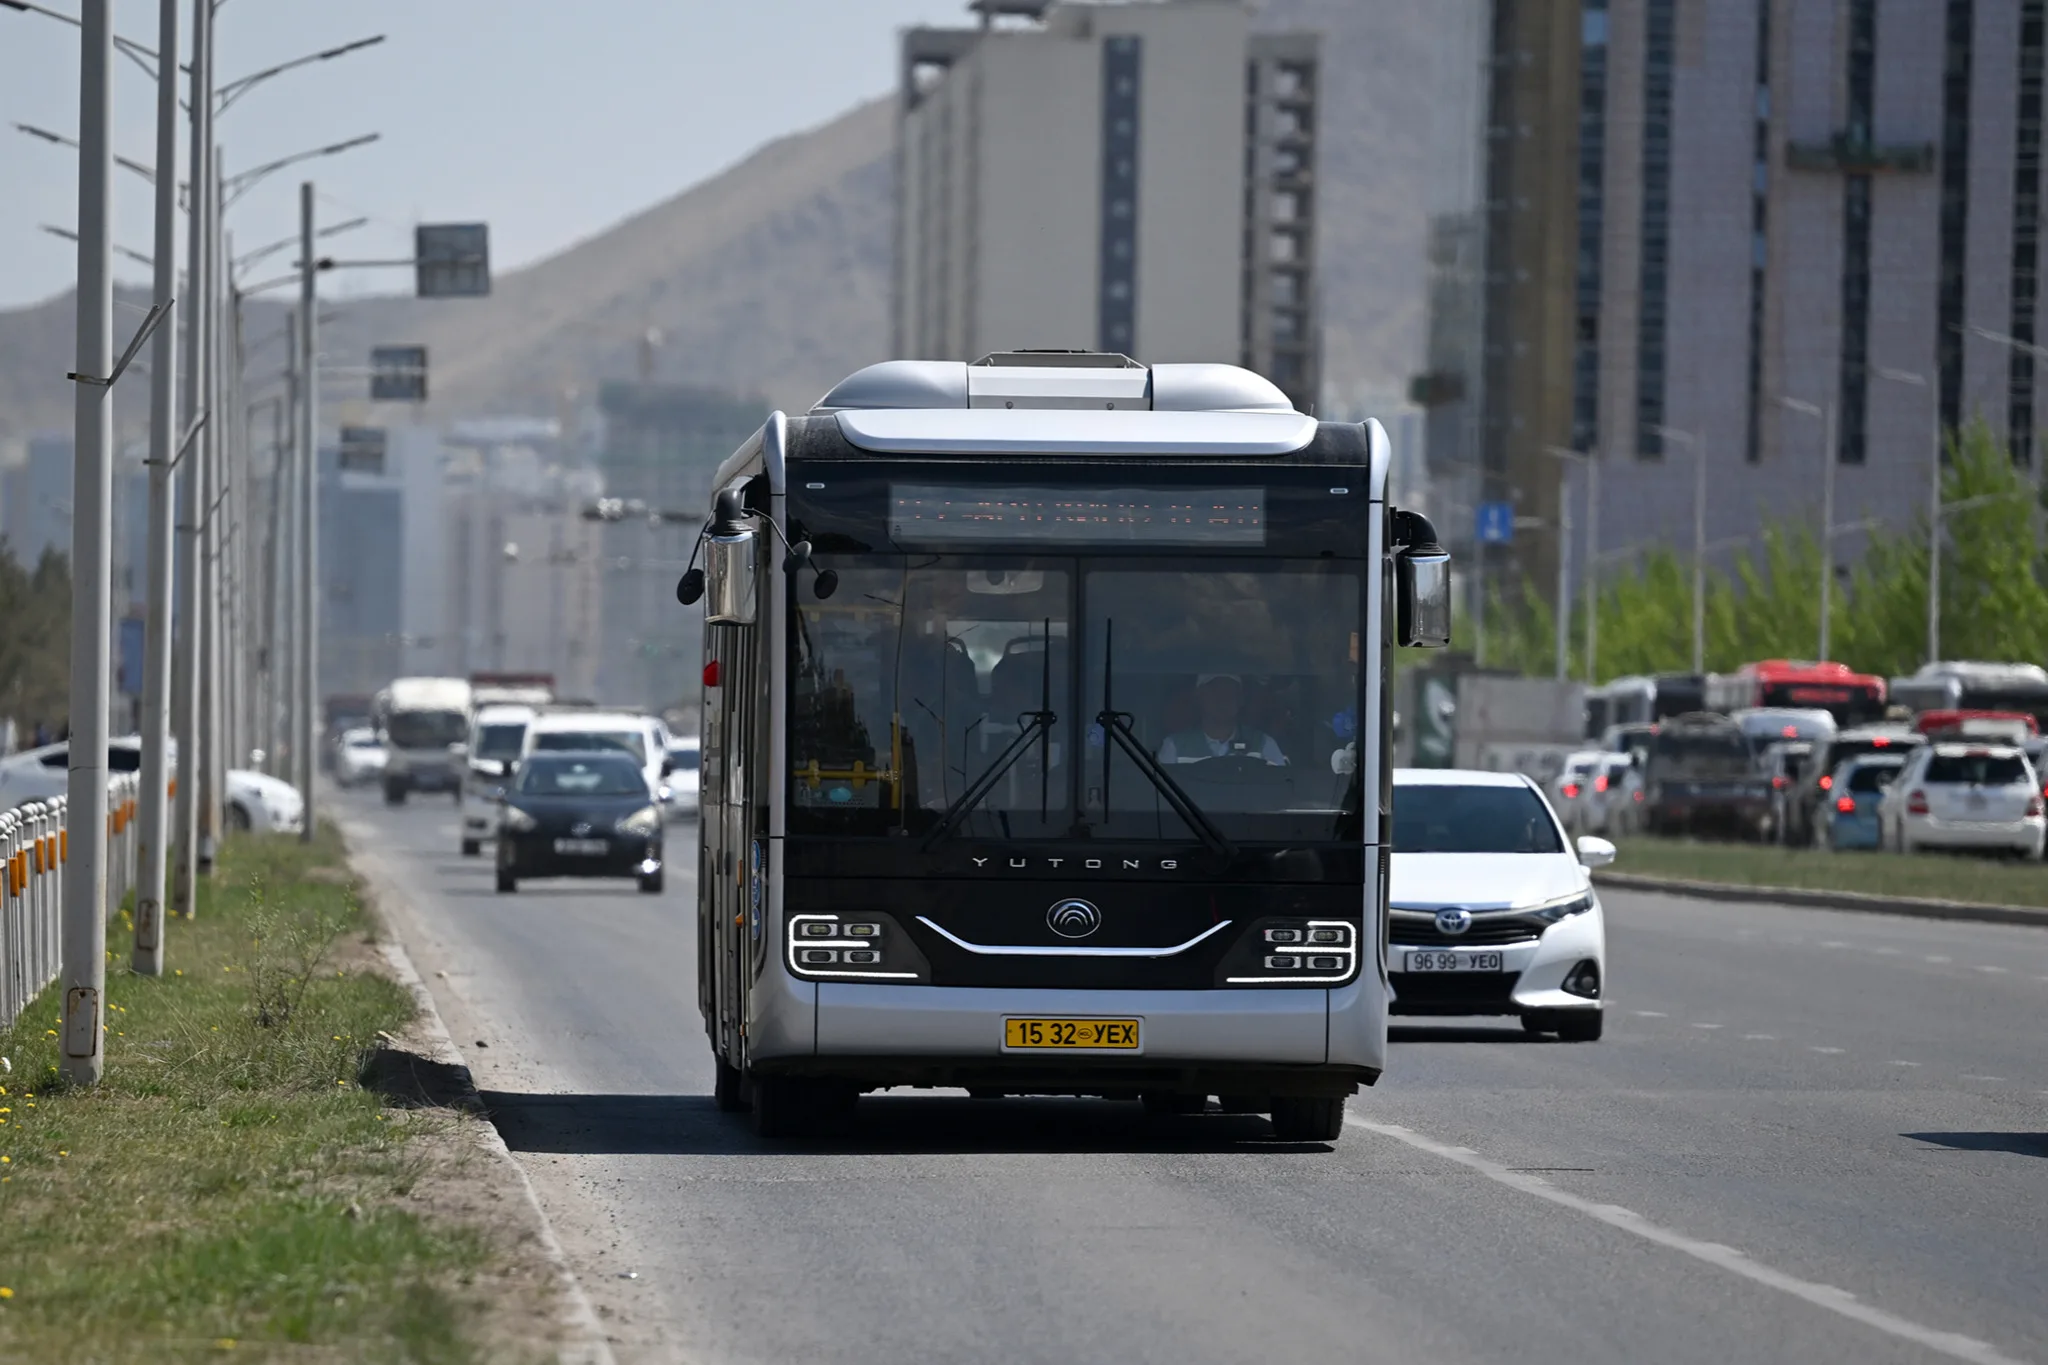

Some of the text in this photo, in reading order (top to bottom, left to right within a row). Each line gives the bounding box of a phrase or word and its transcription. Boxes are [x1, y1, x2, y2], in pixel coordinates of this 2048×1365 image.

[972, 857, 1178, 870] YUTONG
[1019, 1022, 1043, 1044] 15
[1050, 1023, 1076, 1044] 32
